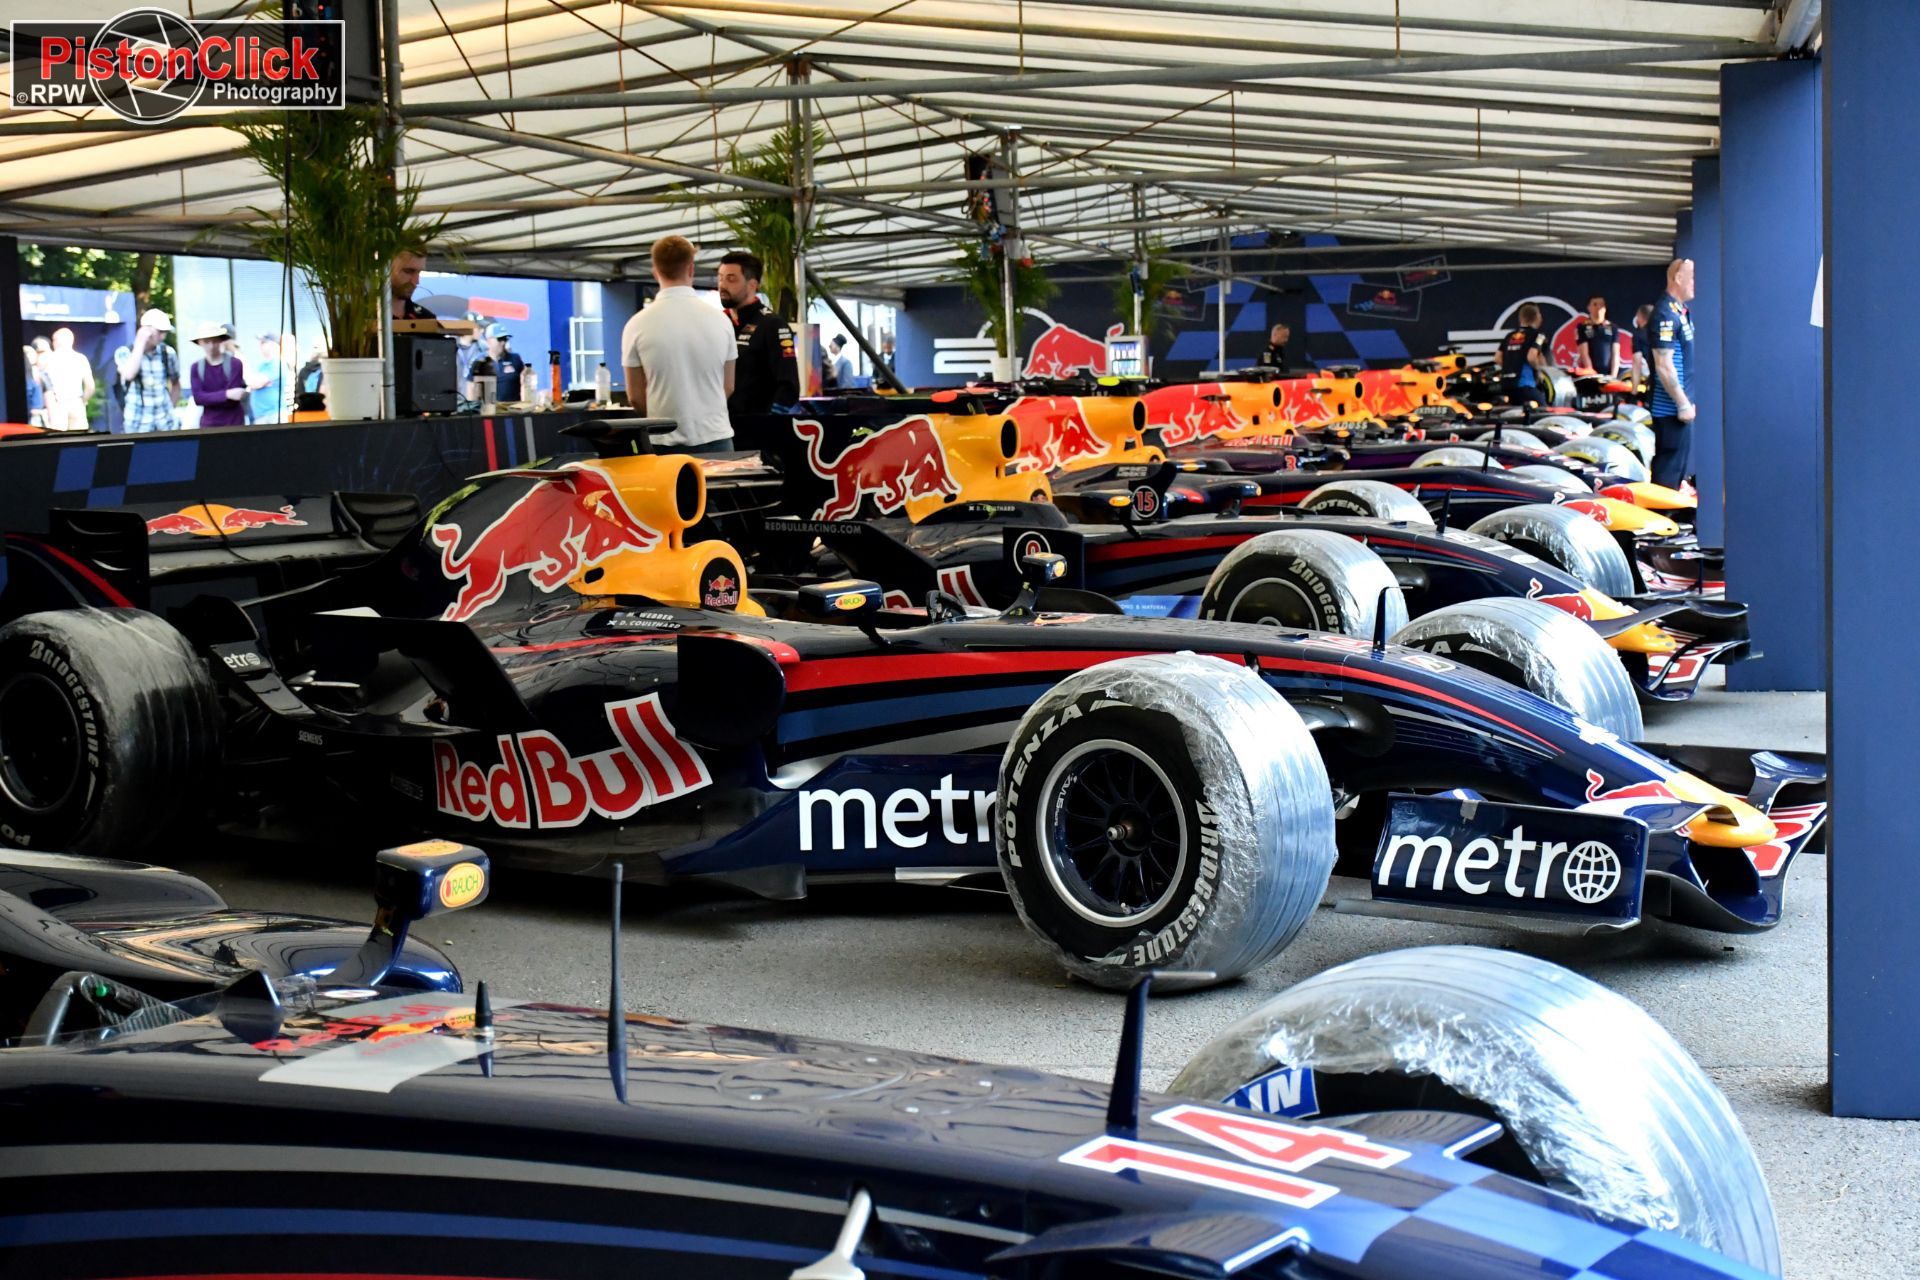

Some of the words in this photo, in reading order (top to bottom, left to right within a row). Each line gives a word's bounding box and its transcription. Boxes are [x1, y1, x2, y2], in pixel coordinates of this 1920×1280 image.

[1137, 491, 1154, 511] 15
[1310, 499, 1370, 517] OTENZ
[764, 521, 861, 534] REDBULLRACING.COM
[639, 612, 674, 621] WEBBER
[1288, 557, 1340, 634] BRIDGEST
[629, 620, 682, 630] COULTHARD
[28, 640, 100, 768] BRIDGESTONE
[1004, 703, 1083, 869] POTENZA
[799, 774, 998, 851] metr
[452, 874, 479, 896] RAUCH
[1134, 799, 1220, 966] BRIDGESTONE
[1377, 824, 1621, 904] metro
